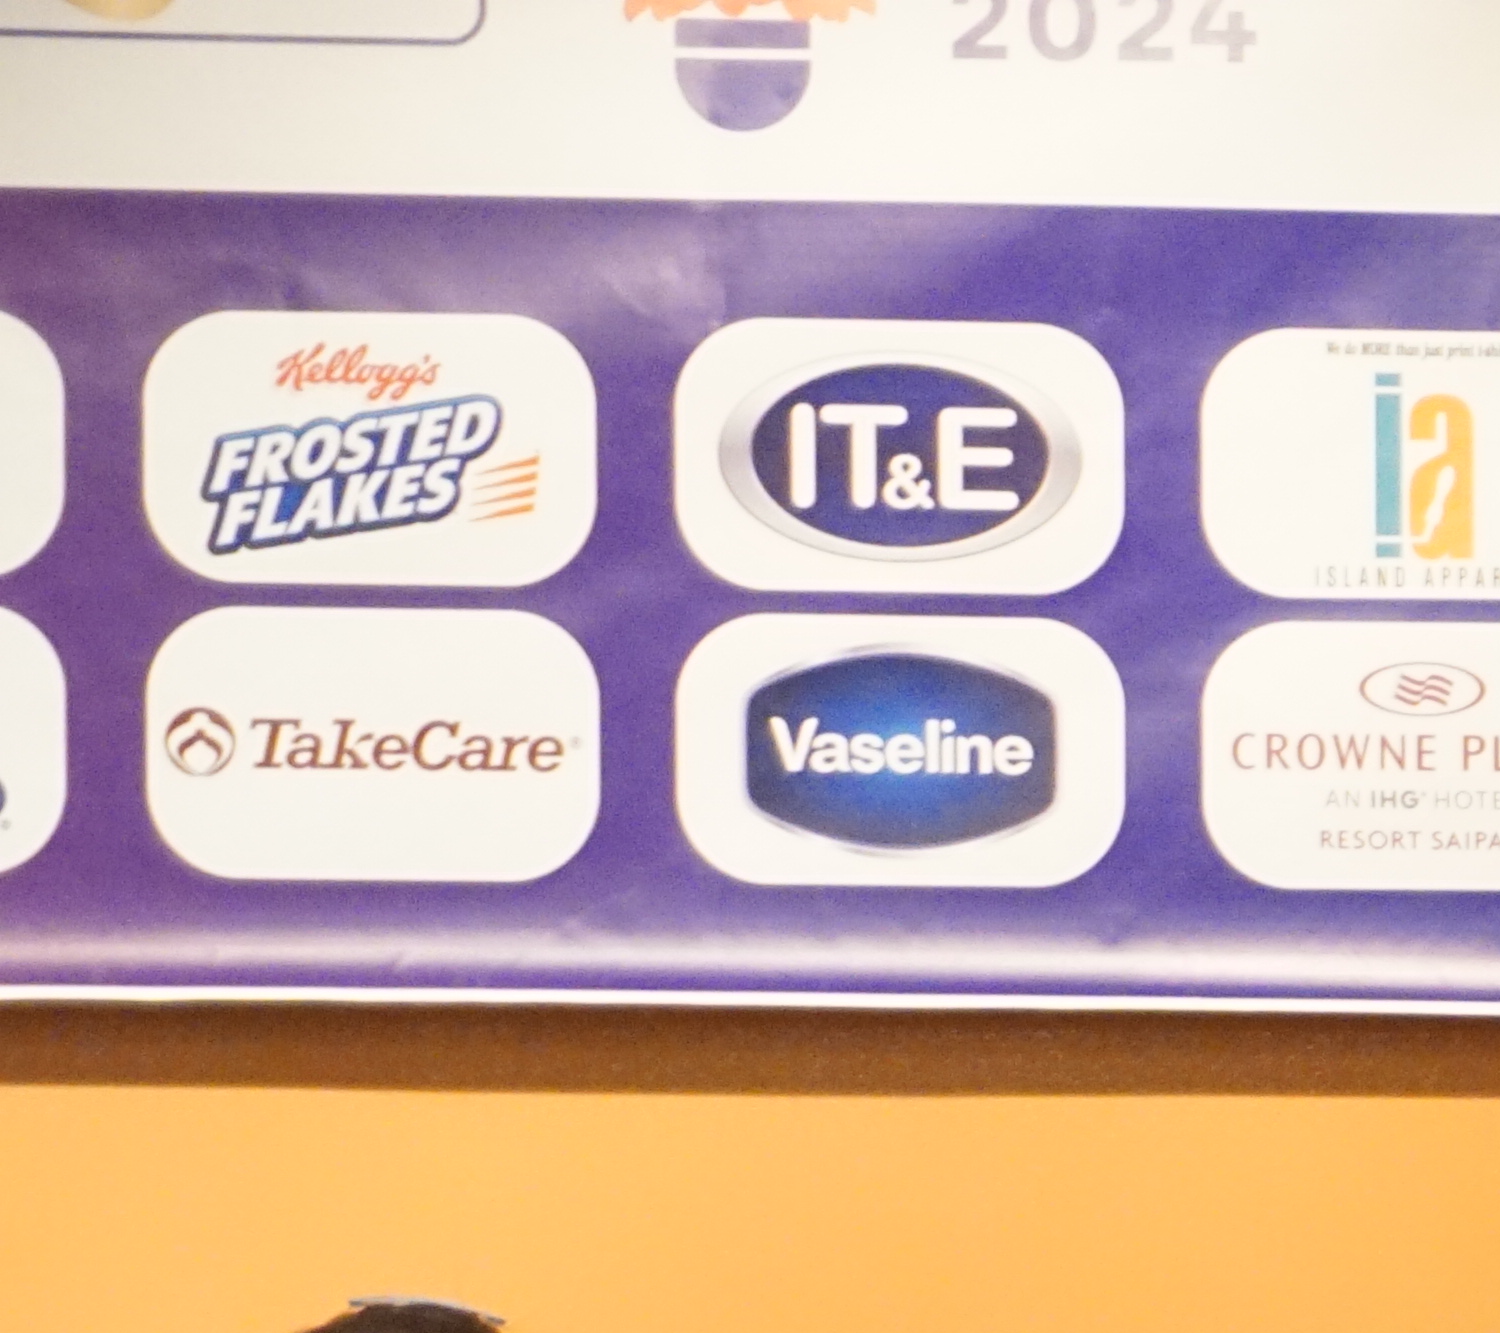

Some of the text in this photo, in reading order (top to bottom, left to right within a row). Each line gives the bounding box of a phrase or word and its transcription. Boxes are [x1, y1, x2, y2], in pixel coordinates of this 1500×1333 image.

[952, 0, 1257, 63] 2024
[274, 342, 440, 400] Kellogg's
[208, 398, 500, 496] FROSTED
[789, 402, 1020, 512] IT&E
[215, 458, 460, 548] FLAKES
[1313, 566, 1405, 590] ISLAND
[249, 718, 564, 771] TakeCare
[768, 715, 1035, 776] Vaseline
[1231, 733, 1437, 773] CROWNE
[1325, 791, 1361, 810] AN
[1319, 830, 1421, 851] RESORT
